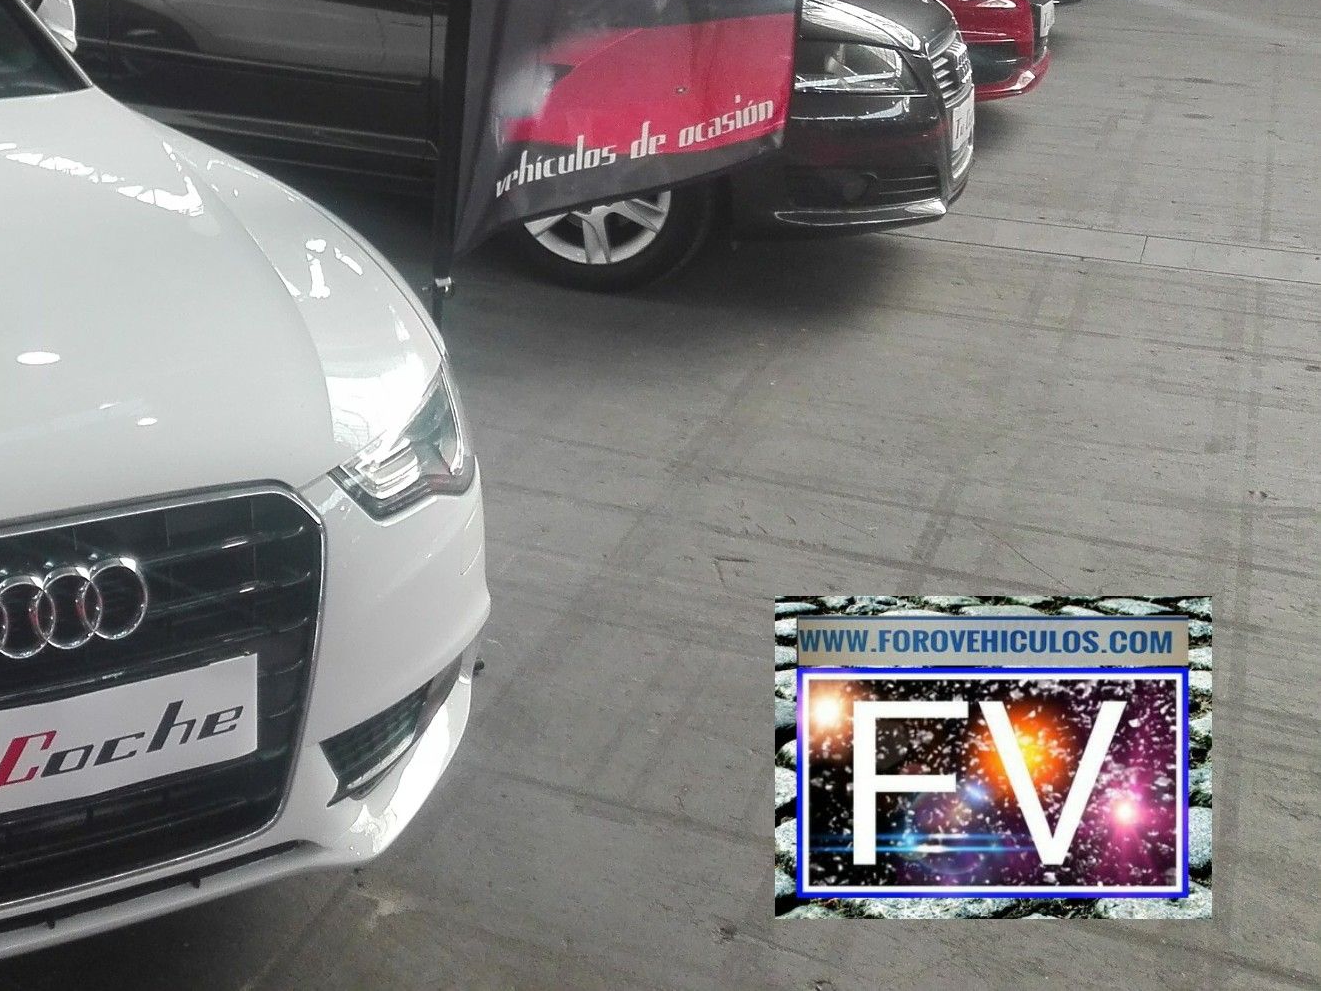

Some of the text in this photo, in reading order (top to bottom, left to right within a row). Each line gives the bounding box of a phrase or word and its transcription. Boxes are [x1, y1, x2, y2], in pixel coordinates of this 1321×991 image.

[495, 94, 775, 199] vehículos de ocasión
